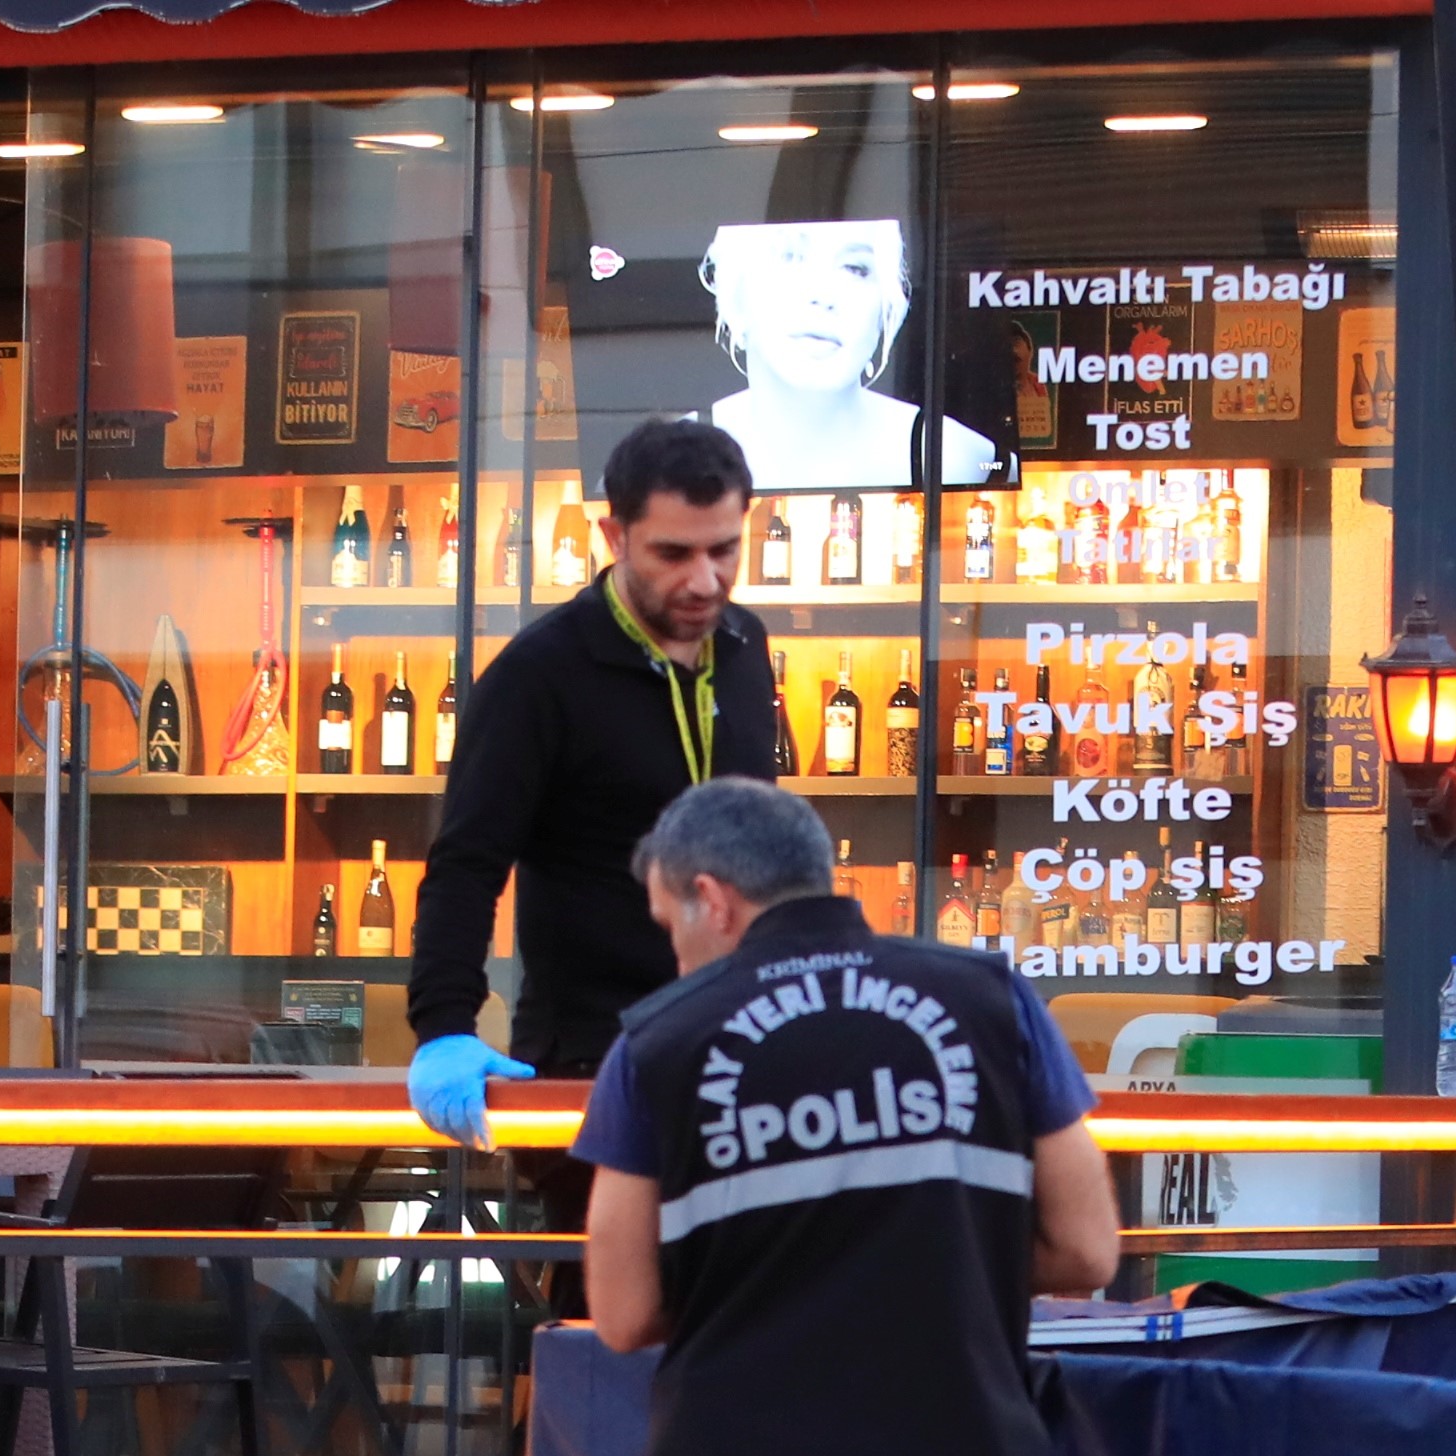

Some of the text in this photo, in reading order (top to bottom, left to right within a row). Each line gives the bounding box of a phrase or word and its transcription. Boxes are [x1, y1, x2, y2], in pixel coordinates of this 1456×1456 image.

[967, 263, 1346, 310] Kahvaltı Tabağı
[1218, 317, 1299, 355] SARHOŞ
[1037, 347, 1270, 384] Menemen
[287, 381, 348, 397] KULLANIN
[1114, 396, 1183, 414] İFLAS ETTİ
[285, 400, 349, 424] BİTİYOR
[1086, 413, 1192, 450] Tost
[1068, 472, 1211, 508] Omlet
[1025, 621, 1250, 666] Pirzola
[974, 690, 1298, 748] Tavuk Şiş
[1052, 777, 1233, 823] Köfte
[1020, 845, 1265, 904] Çöp şiş
[698, 1045, 744, 1169] OLAY
[739, 1066, 944, 1162] POLİS
